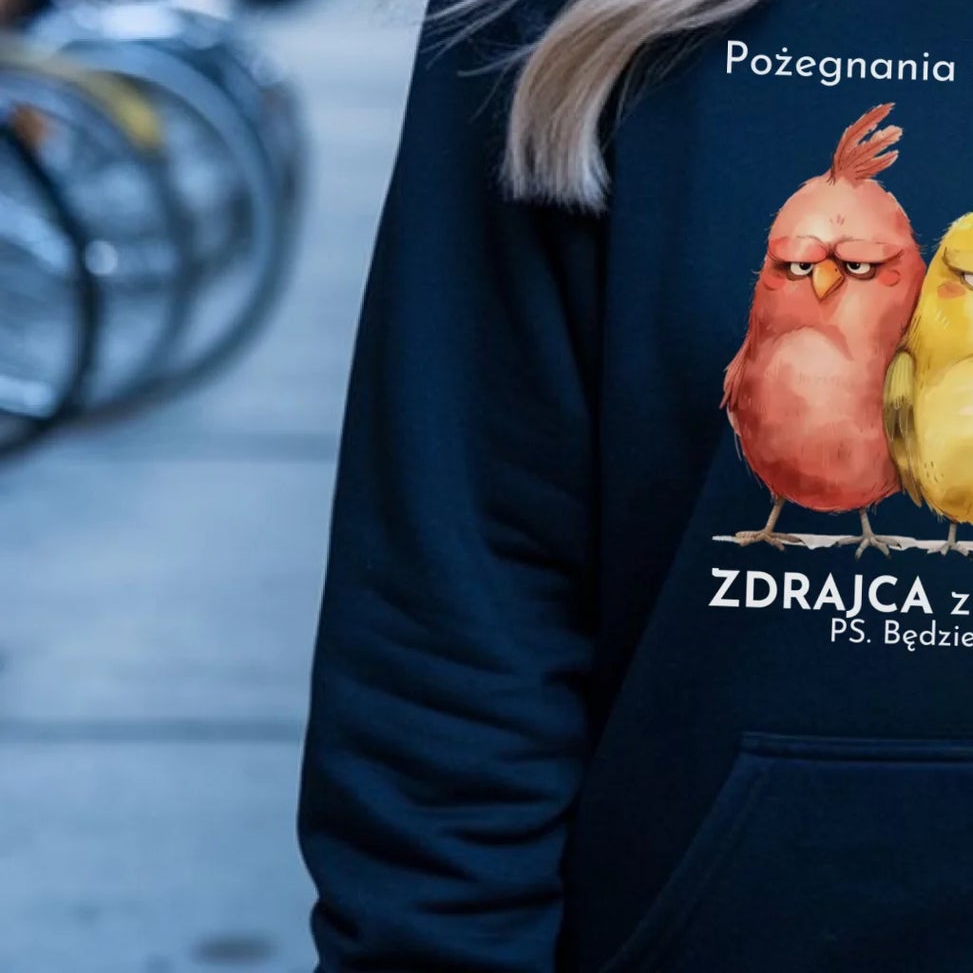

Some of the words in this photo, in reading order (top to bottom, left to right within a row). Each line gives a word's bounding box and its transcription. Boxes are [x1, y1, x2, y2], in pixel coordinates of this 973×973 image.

[725, 40, 956, 87] Pożegnania
[708, 567, 934, 619] ZDRAJCA
[830, 617, 872, 644] PS.
